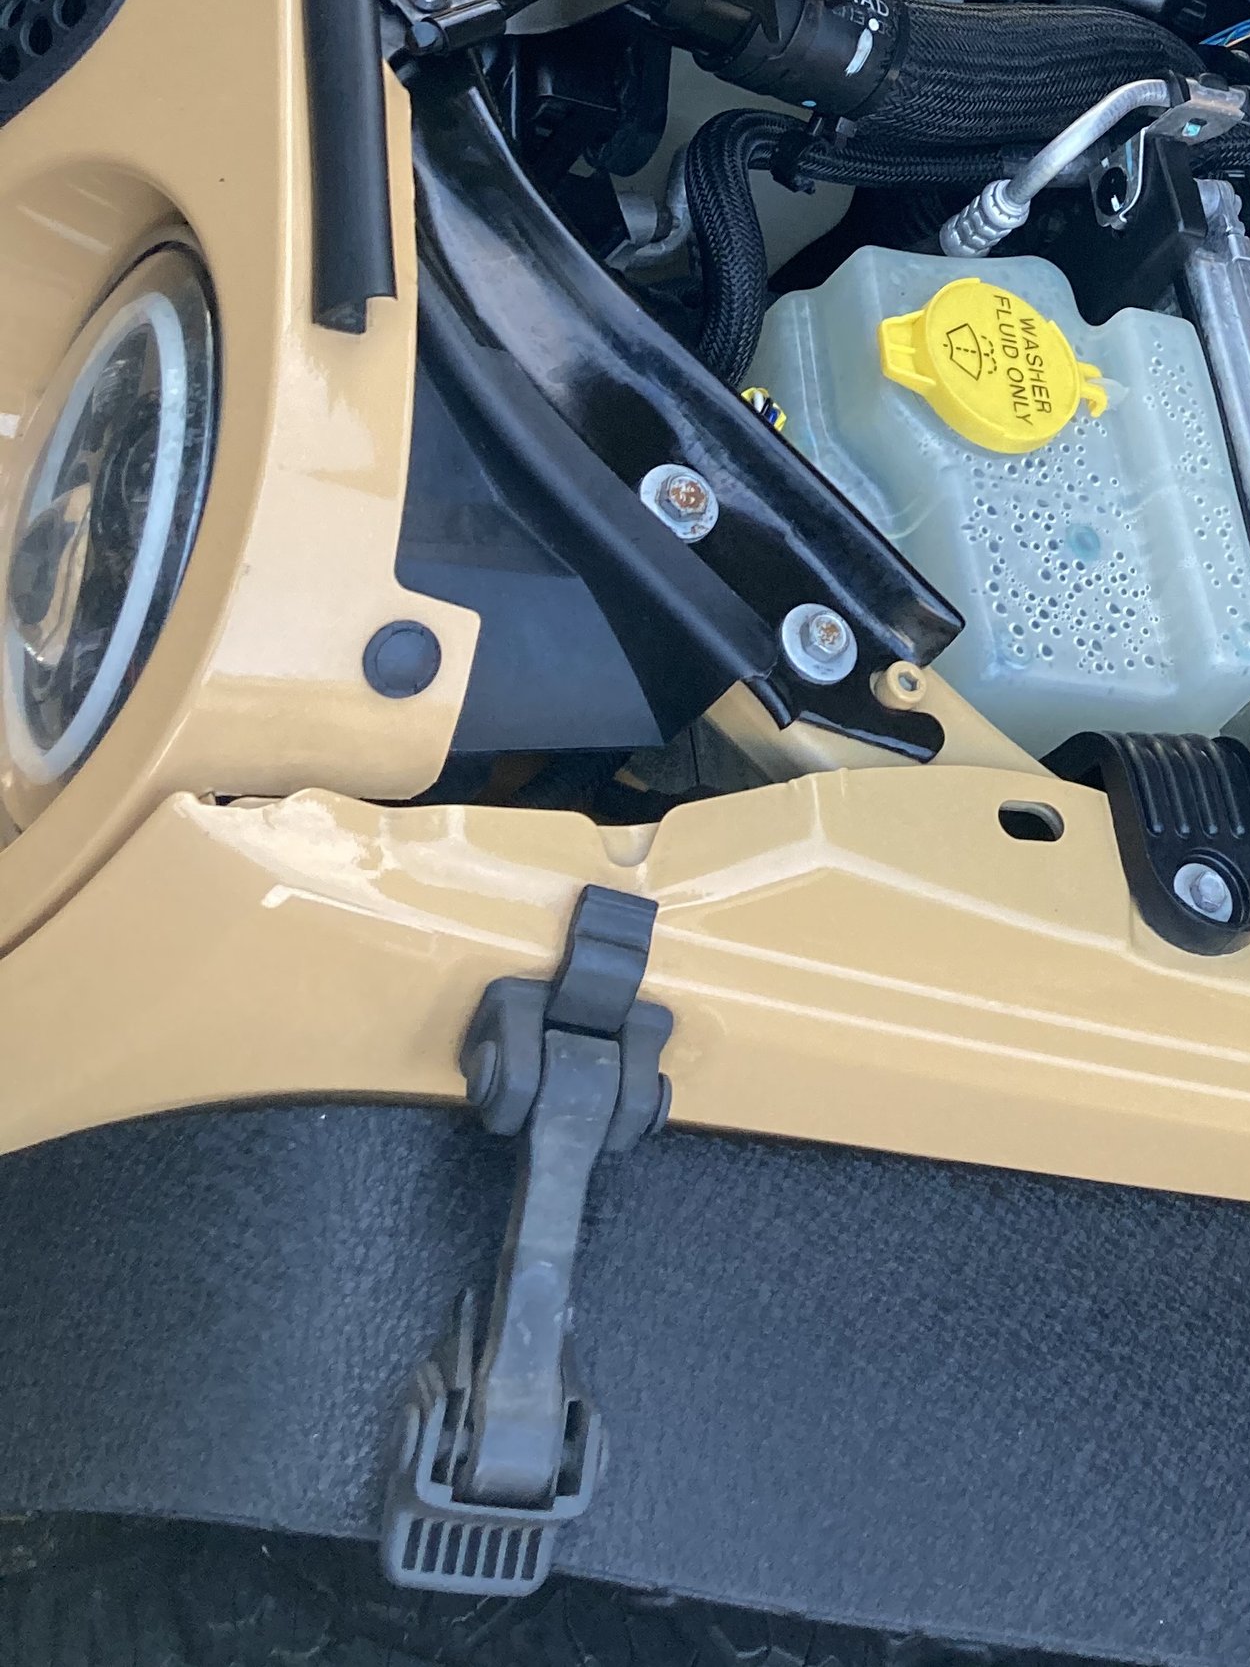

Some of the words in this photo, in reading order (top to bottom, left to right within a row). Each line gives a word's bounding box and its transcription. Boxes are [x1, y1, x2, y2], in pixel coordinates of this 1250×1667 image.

[993, 294, 1019, 359] FLUID
[1006, 367, 1034, 426] ONLY
[1018, 317, 1052, 414] WASHER
